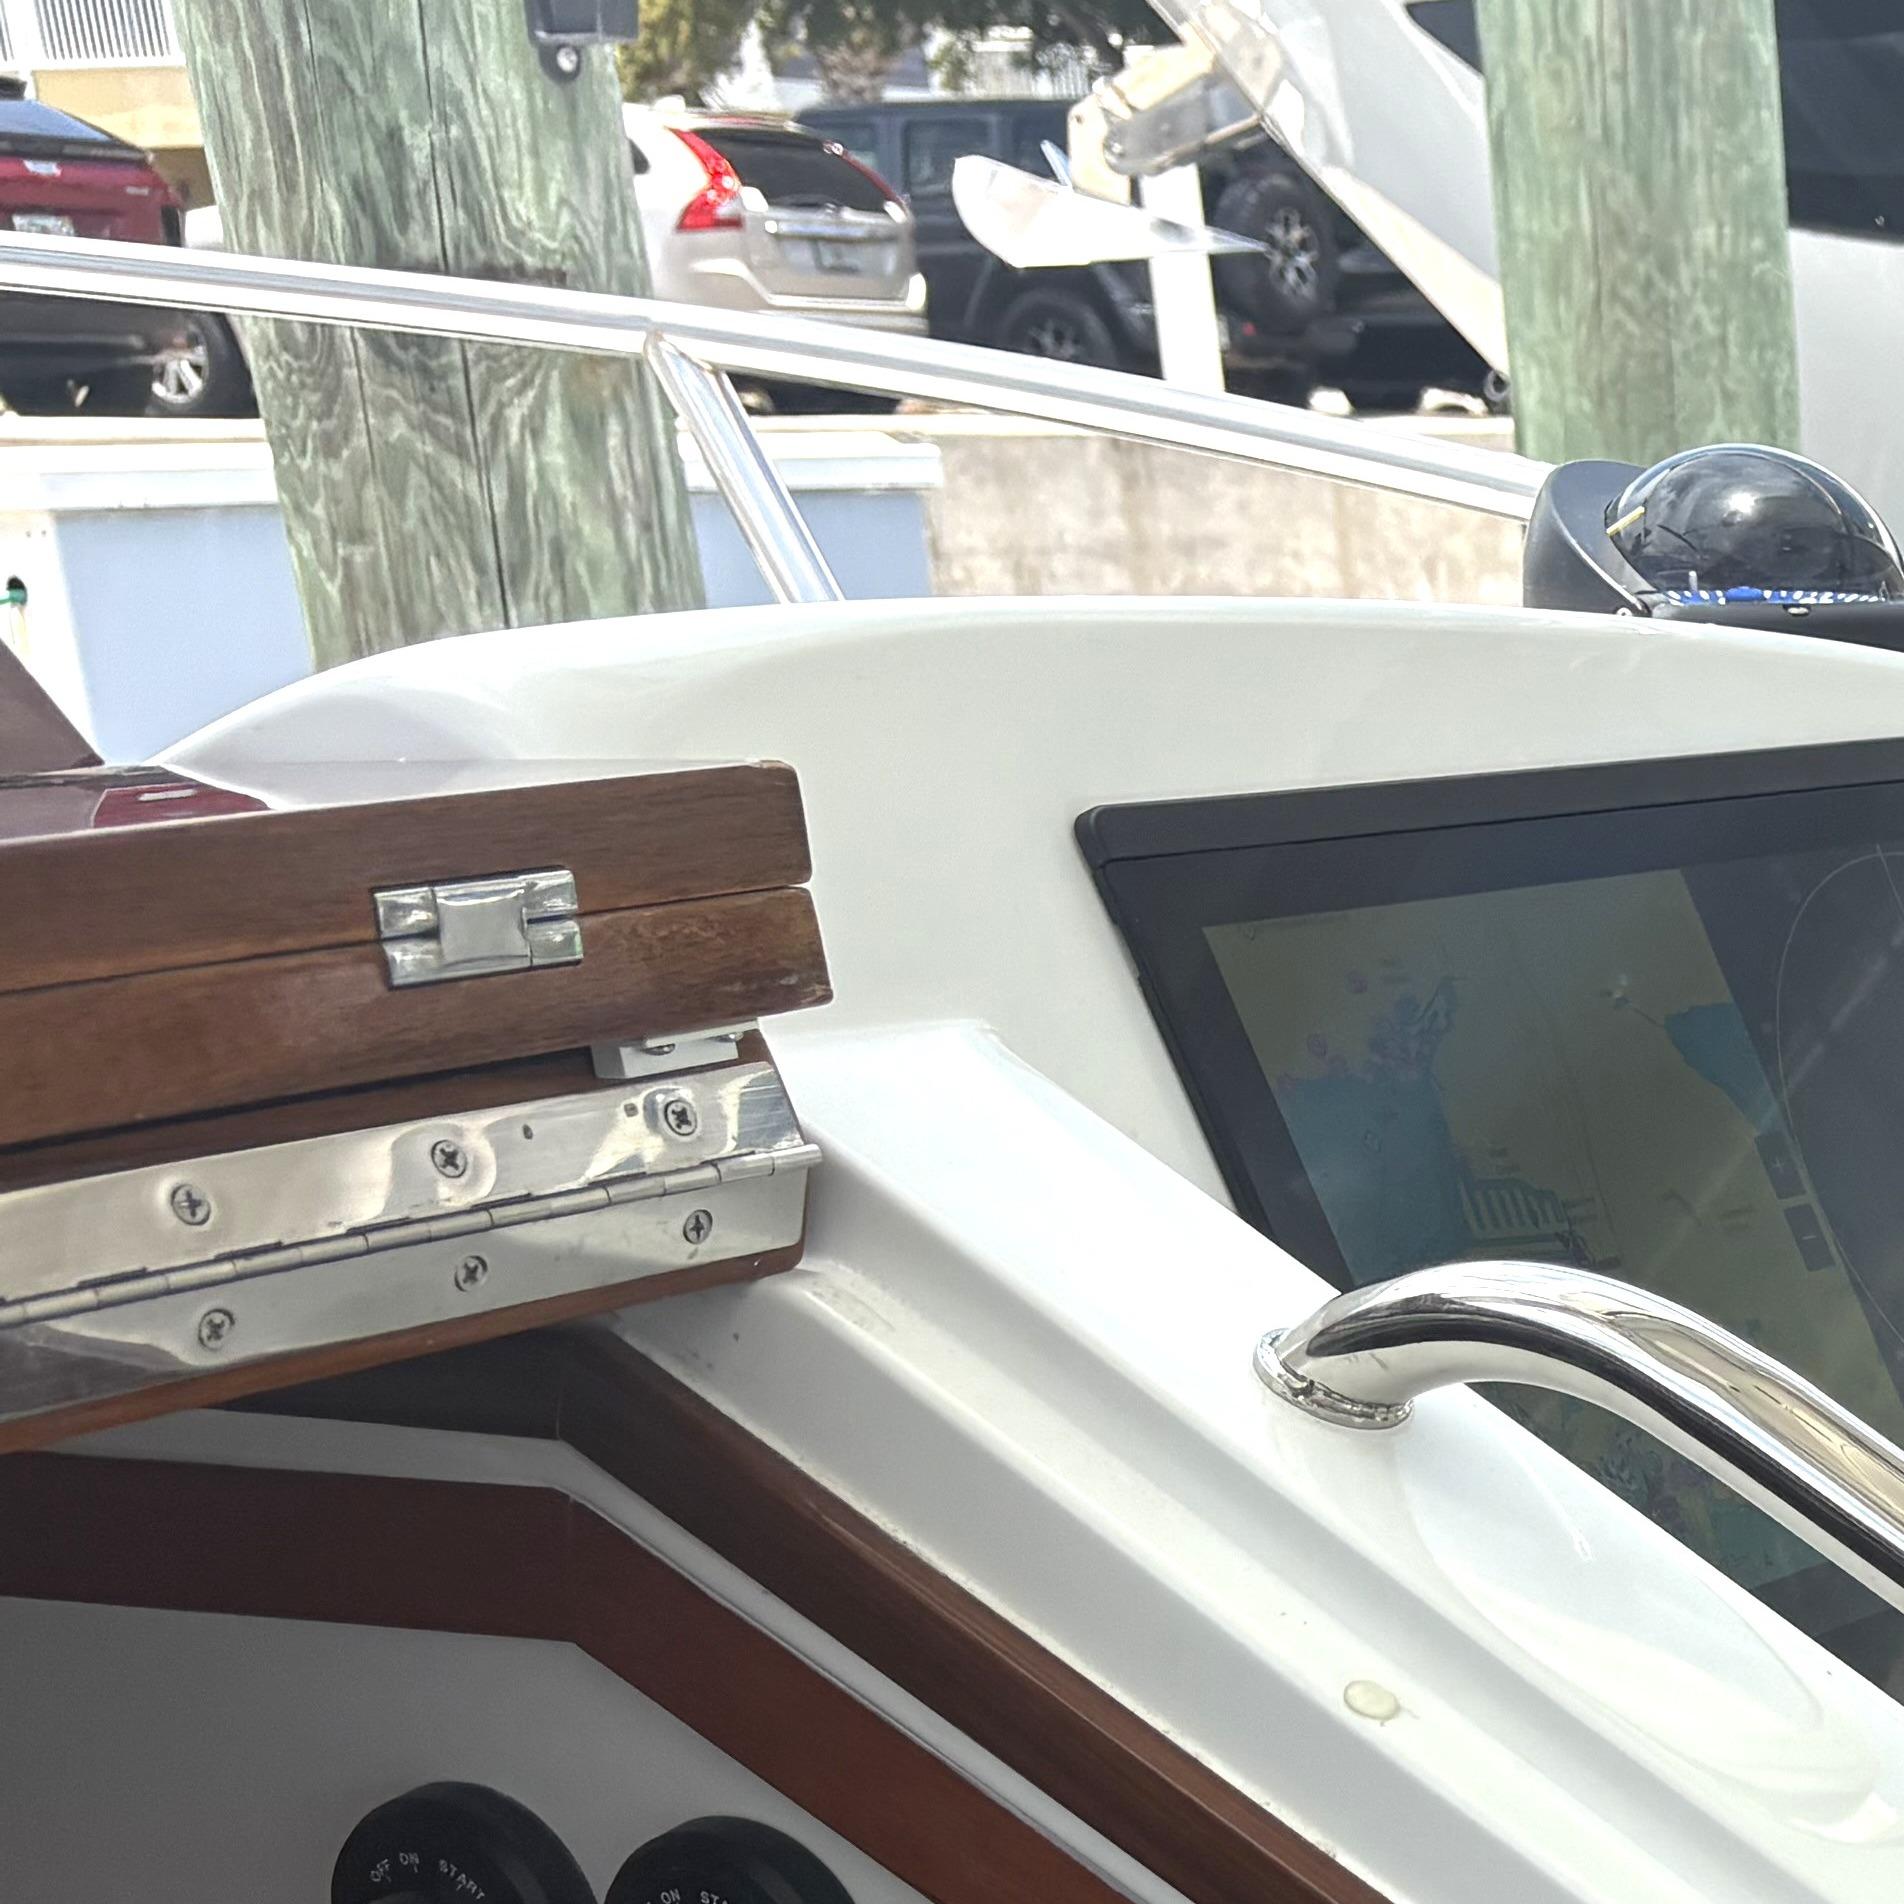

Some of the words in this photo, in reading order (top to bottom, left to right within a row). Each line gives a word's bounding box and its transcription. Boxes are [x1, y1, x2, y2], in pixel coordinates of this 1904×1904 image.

[370, 1858, 391, 1882] OFF
[400, 1852, 420, 1866] ON
[439, 1859, 486, 1900] START
[660, 1888, 681, 1904] ON
